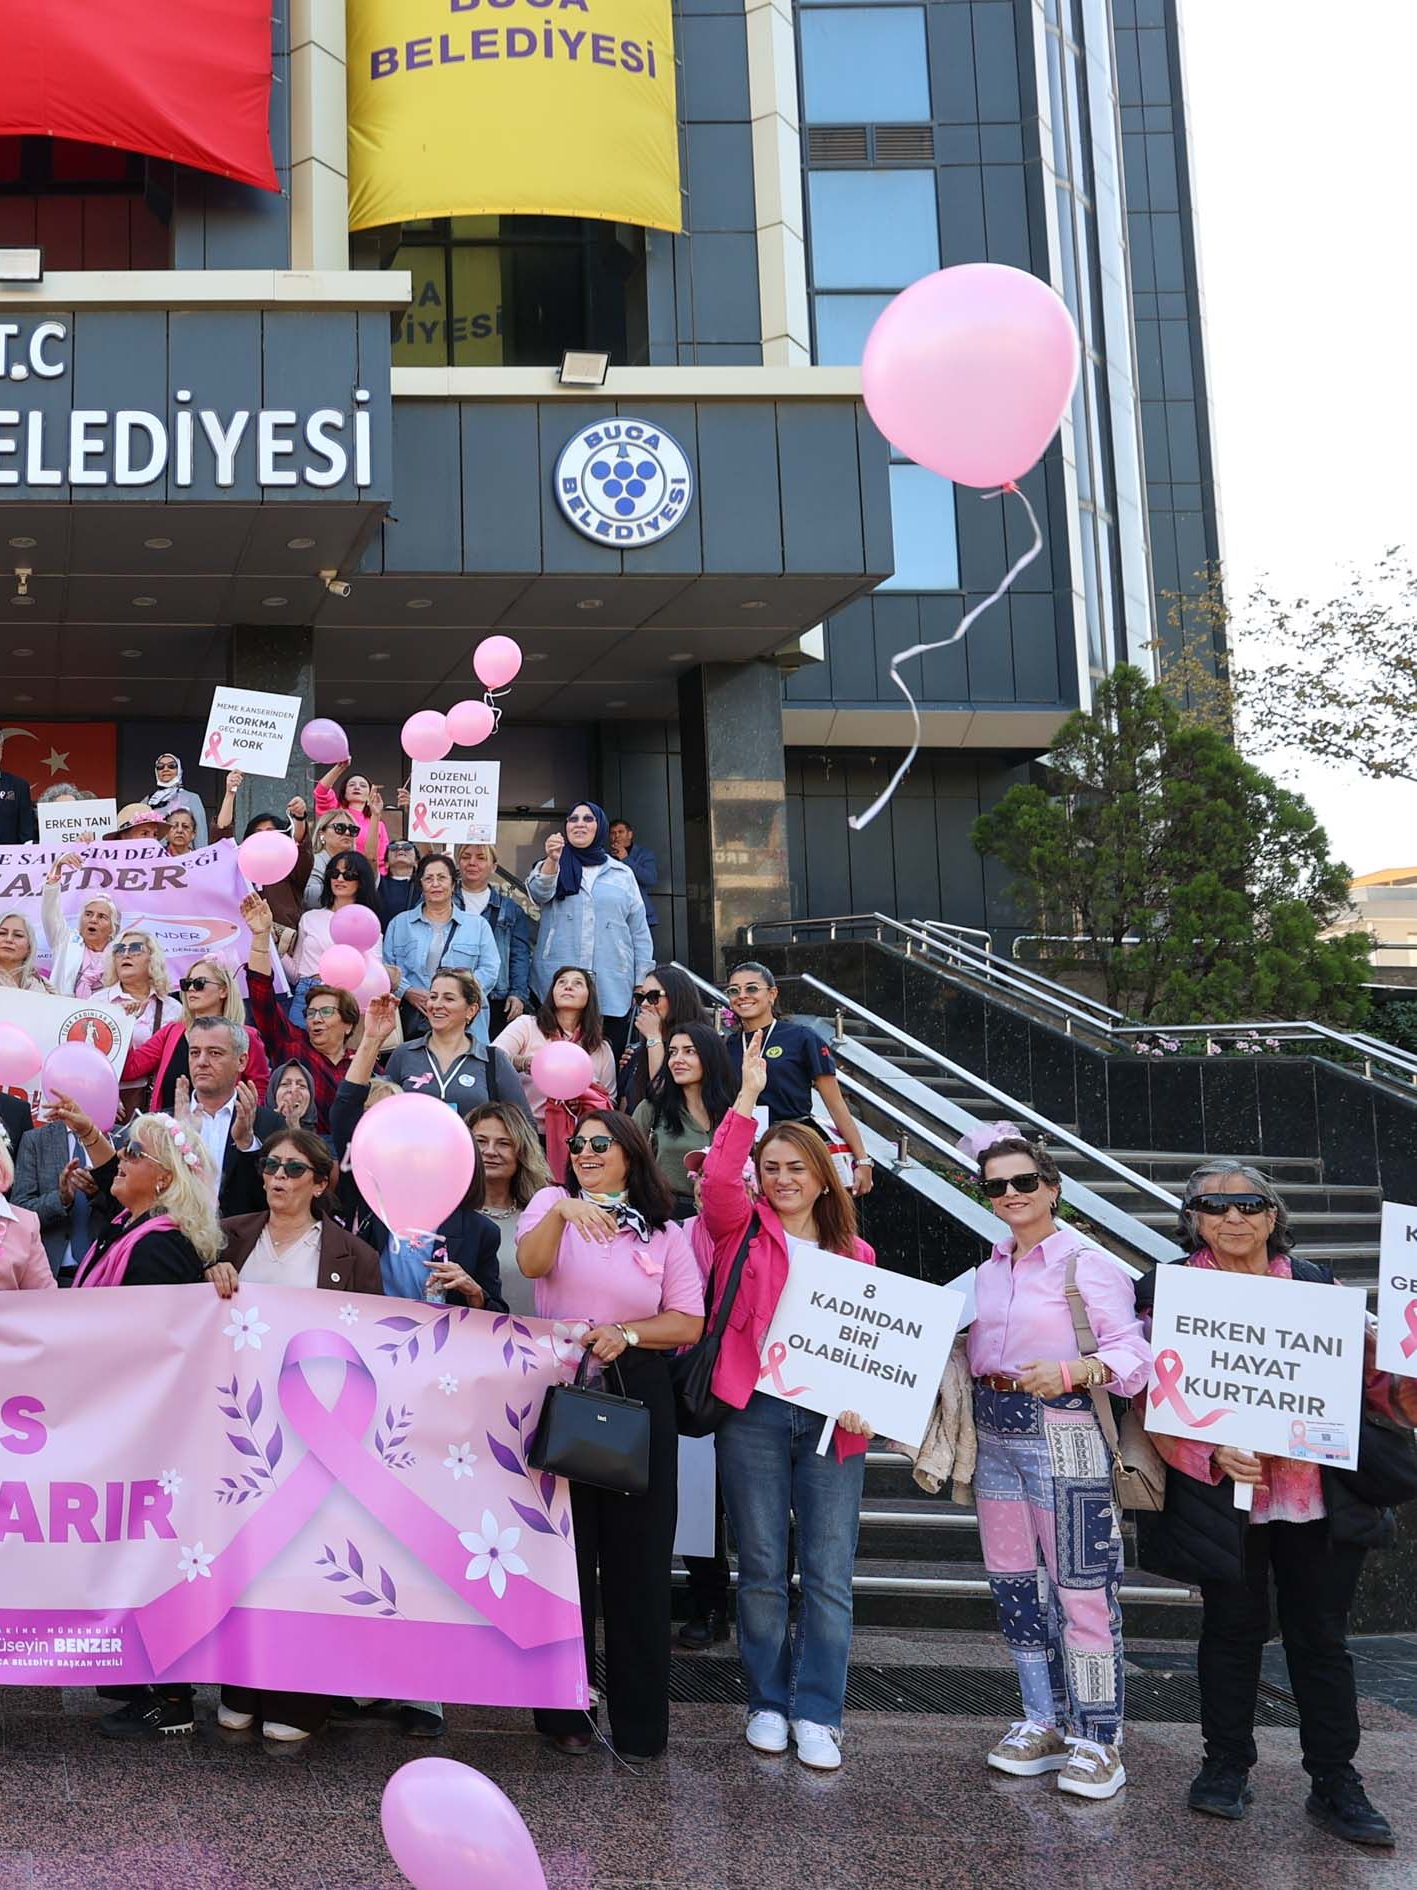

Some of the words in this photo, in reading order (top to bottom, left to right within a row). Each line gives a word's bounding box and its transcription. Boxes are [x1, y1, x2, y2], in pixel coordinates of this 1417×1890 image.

[371, 20, 656, 80] BELEDİYESİ
[583, 425, 660, 451] BUCA
[216, 702, 239, 712] MEME
[228, 715, 277, 730] KORKMA
[232, 738, 264, 751] KORK
[430, 770, 477, 782] DÜZENLİ
[419, 784, 471, 795] KONTROL
[474, 786, 490, 795] OL
[429, 798, 478, 808] HAYATINI
[45, 818, 82, 829] ERKEN
[85, 816, 111, 827] TANI
[431, 811, 475, 821] KURTAR
[155, 931, 201, 941] NDER
[862, 1284, 877, 1299] 8
[810, 1291, 923, 1339] KADINDAN
[838, 1325, 880, 1350] BİRİ
[1175, 1314, 1266, 1346] ERKEN
[1275, 1328, 1343, 1358] TANI
[788, 1334, 917, 1389] OLABİLİRSİN
[1210, 1350, 1301, 1381] HAYAT
[1184, 1376, 1326, 1417] KURTARIR
[54, 1638, 122, 1653] BENZER
[12, 1657, 54, 1666] BELEDİYE
[57, 1659, 93, 1669] BAŞKAN
